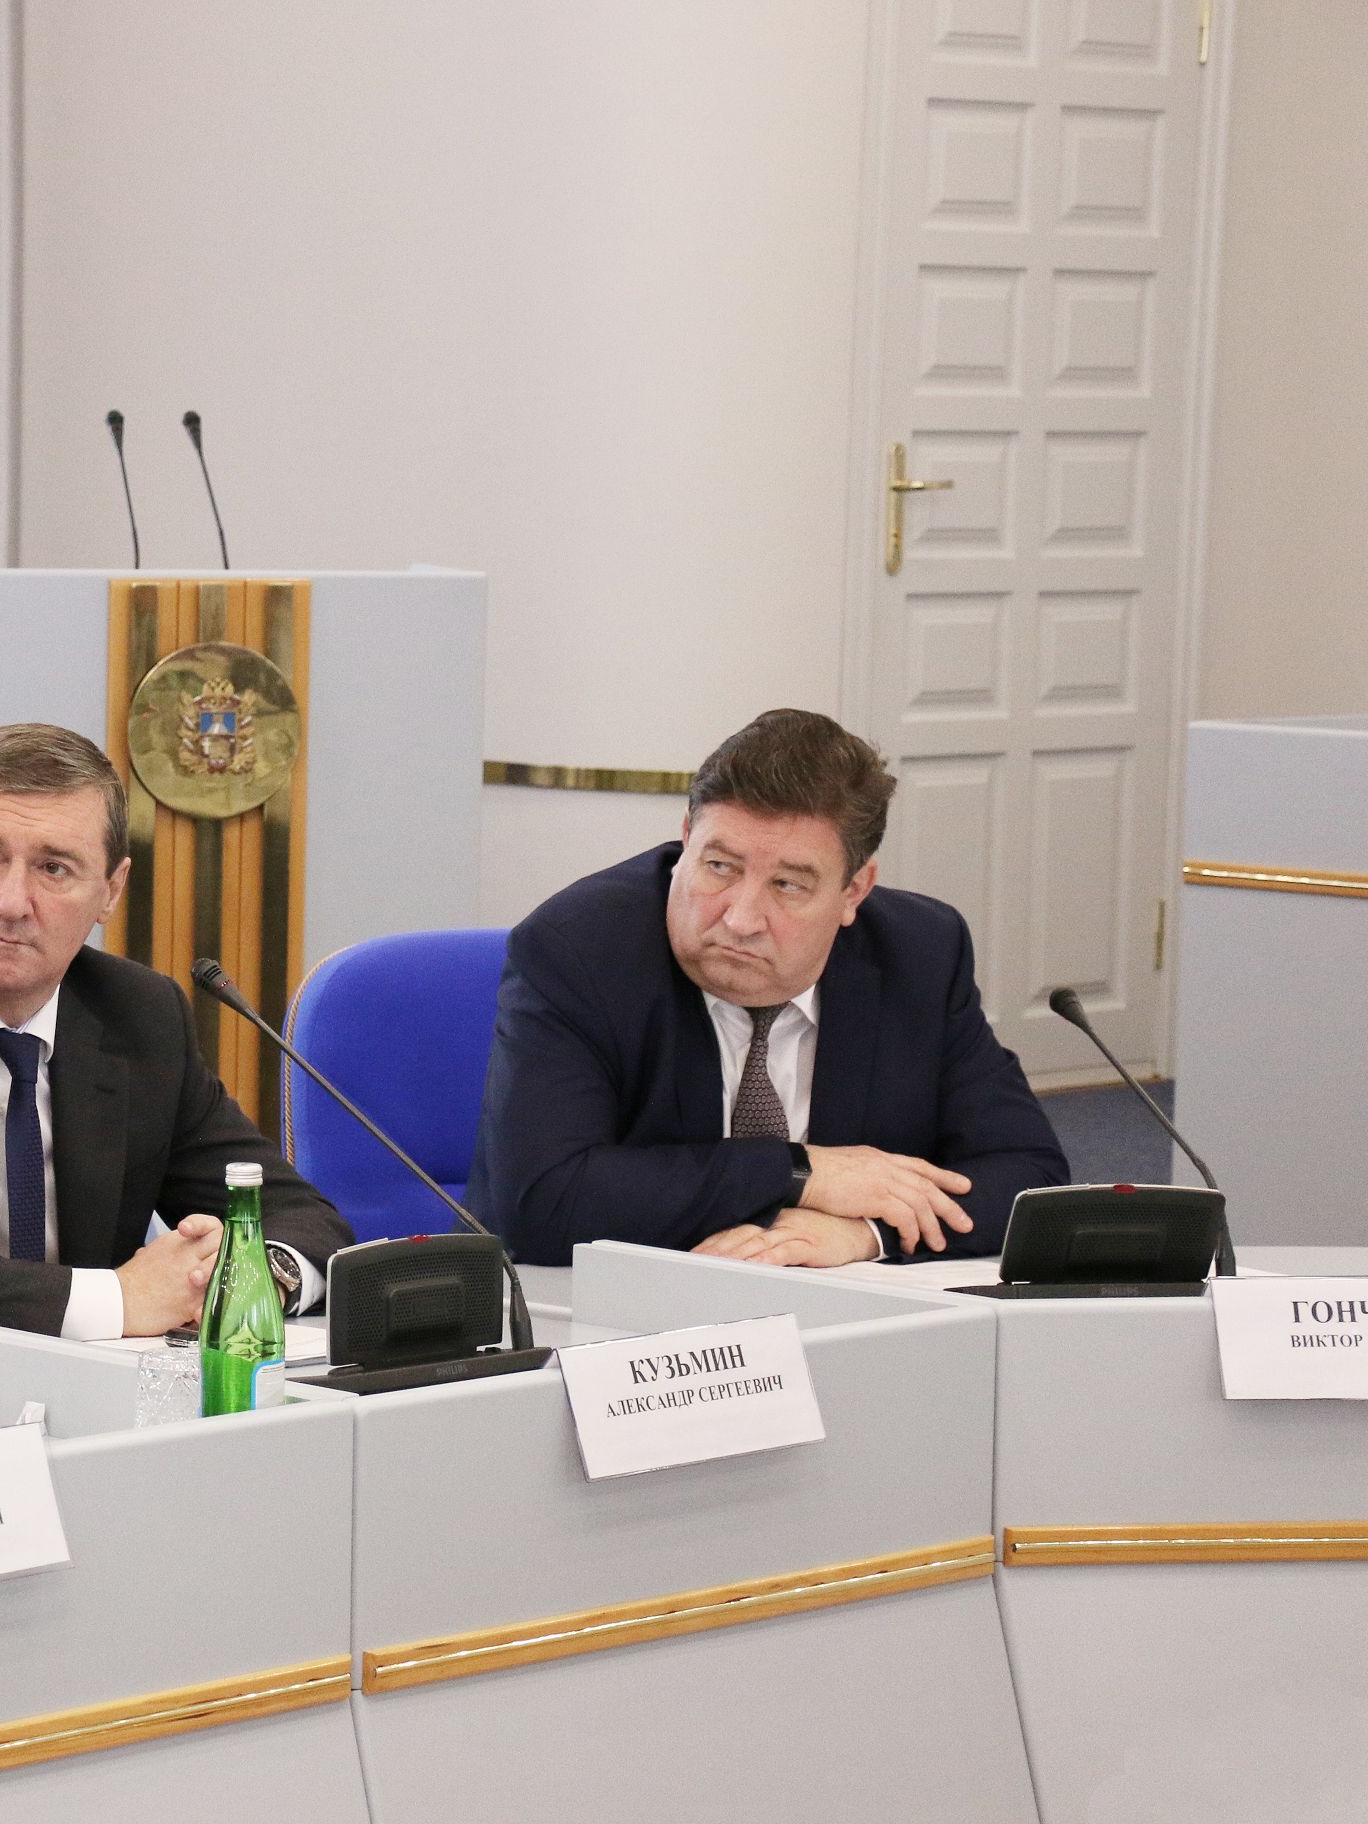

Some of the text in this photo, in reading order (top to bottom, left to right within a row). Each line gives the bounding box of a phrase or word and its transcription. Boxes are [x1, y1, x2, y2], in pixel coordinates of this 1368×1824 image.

[1101, 1286, 1139, 1296] PHILIPS
[1291, 1334, 1363, 1348] ВИКТОР
[436, 1364, 468, 1376] PHILIPS
[628, 1344, 747, 1385] КУЗЬМИН
[606, 1374, 784, 1418] АЛЕКСАНДР СЕРГЕЕВИЧ
